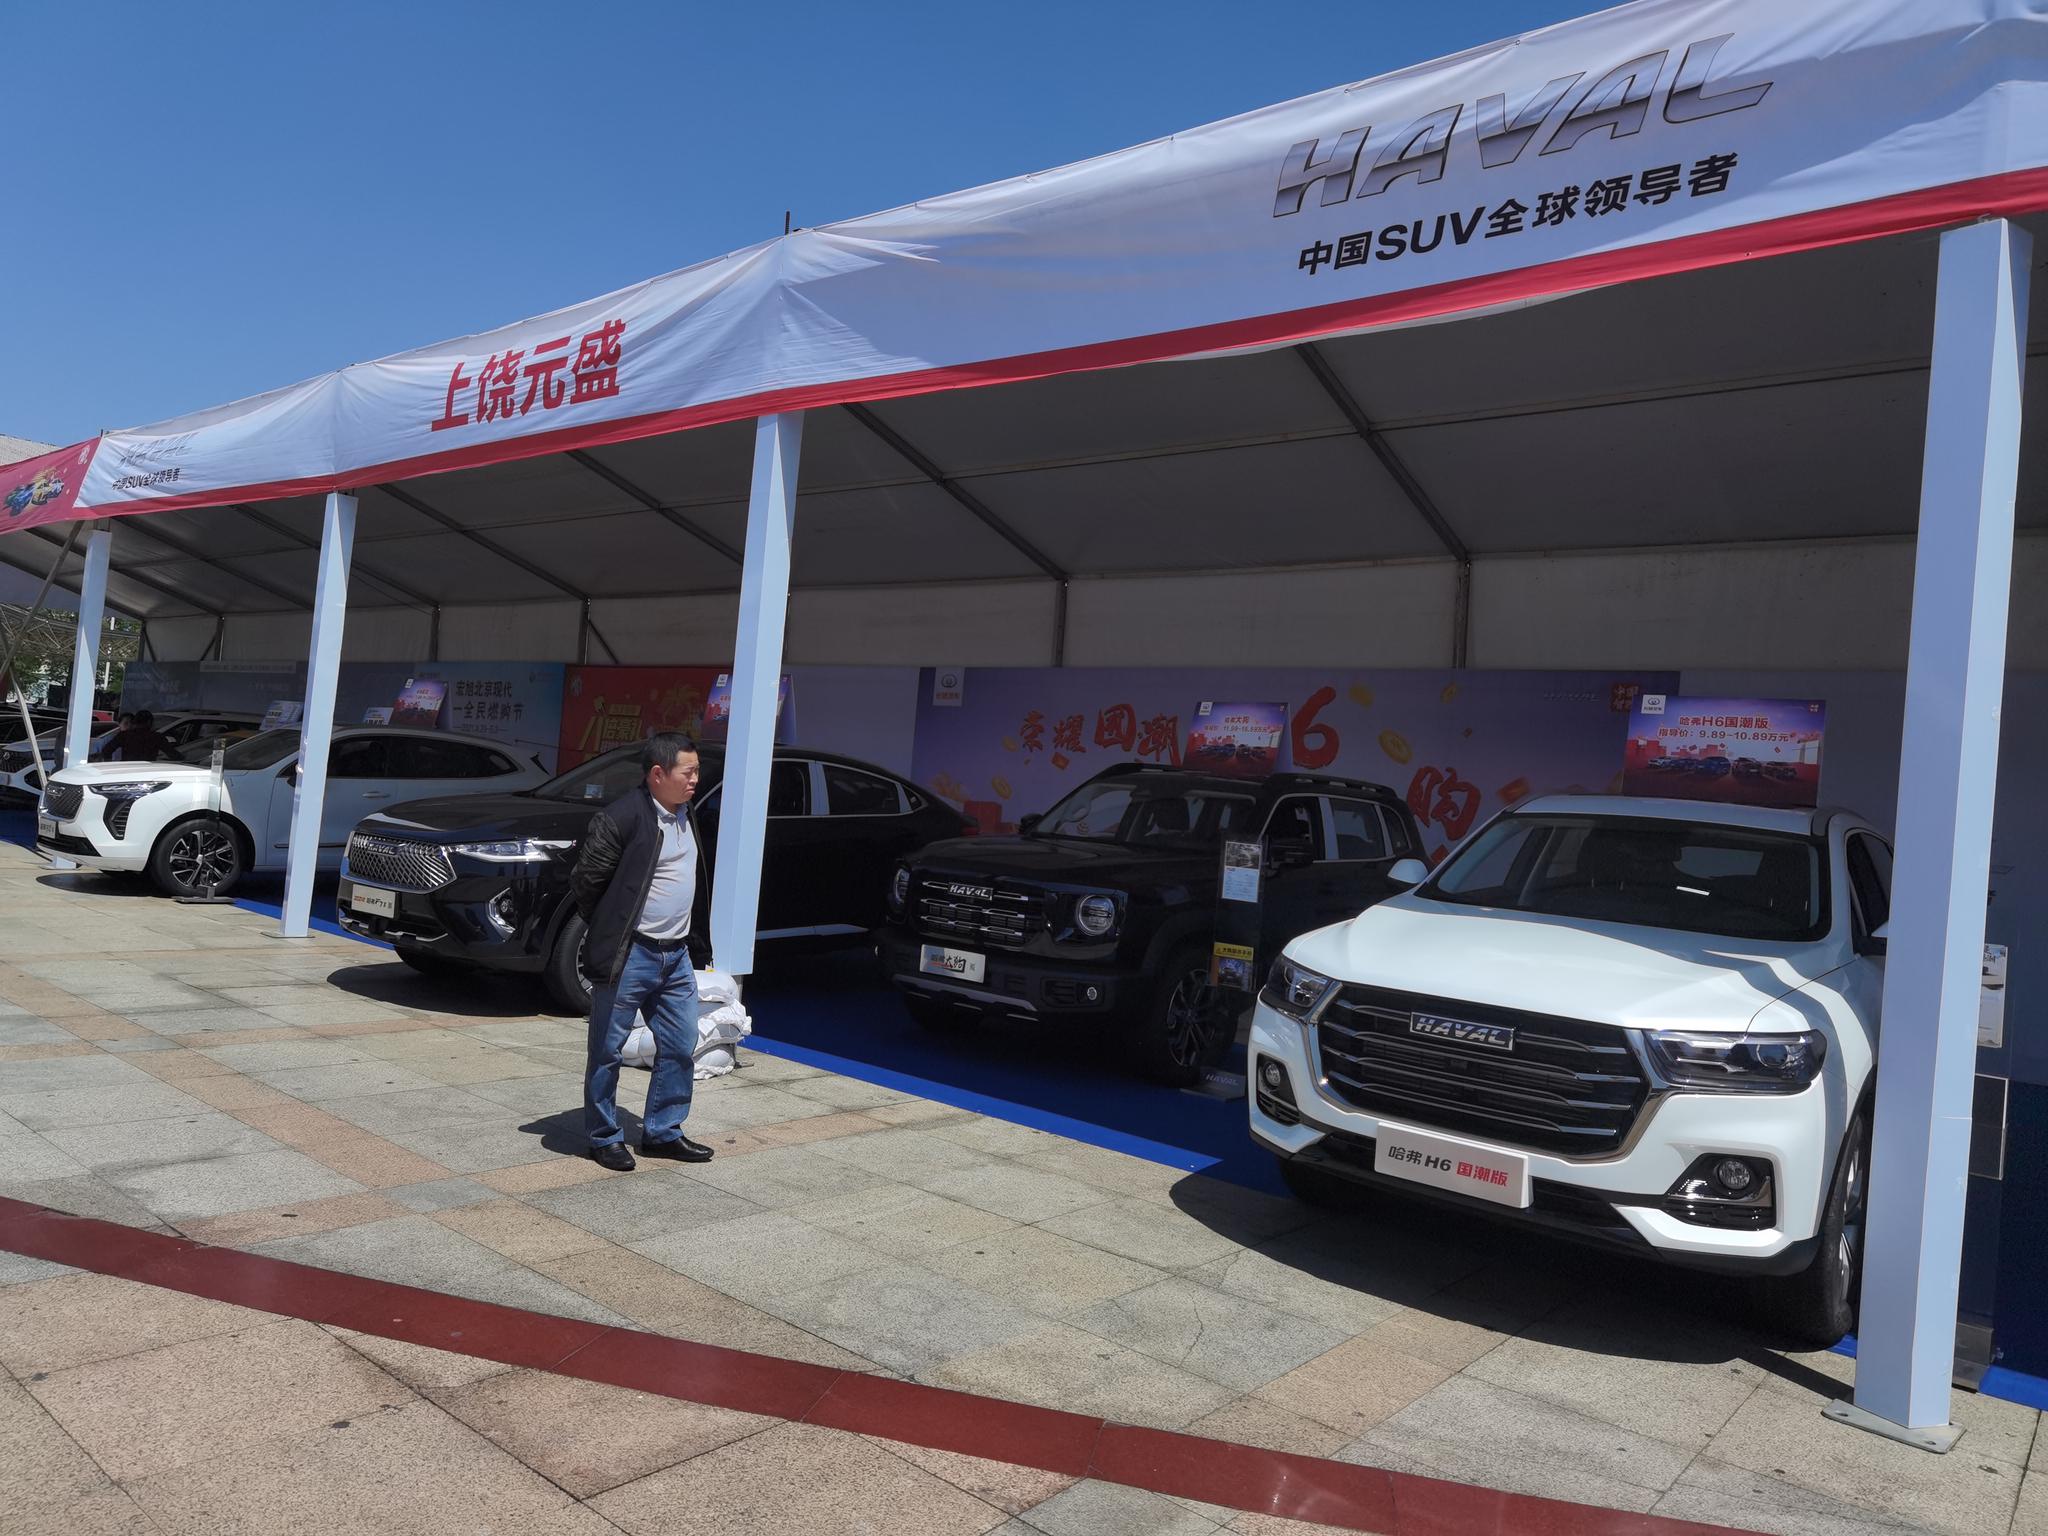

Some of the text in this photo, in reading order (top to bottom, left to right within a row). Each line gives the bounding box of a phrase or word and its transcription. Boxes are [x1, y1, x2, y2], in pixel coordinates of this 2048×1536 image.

[1273, 33, 1774, 217] HAVAL
[1298, 152, 1738, 275] 中国SUV全球领导者
[431, 319, 626, 432] 上饶元盛
[1291, 685, 1339, 769] 6
[1679, 716, 1768, 730] 哈弗H6国潮版
[949, 884, 989, 898] HAVAL
[1416, 1017, 1506, 1045] HAVAL
